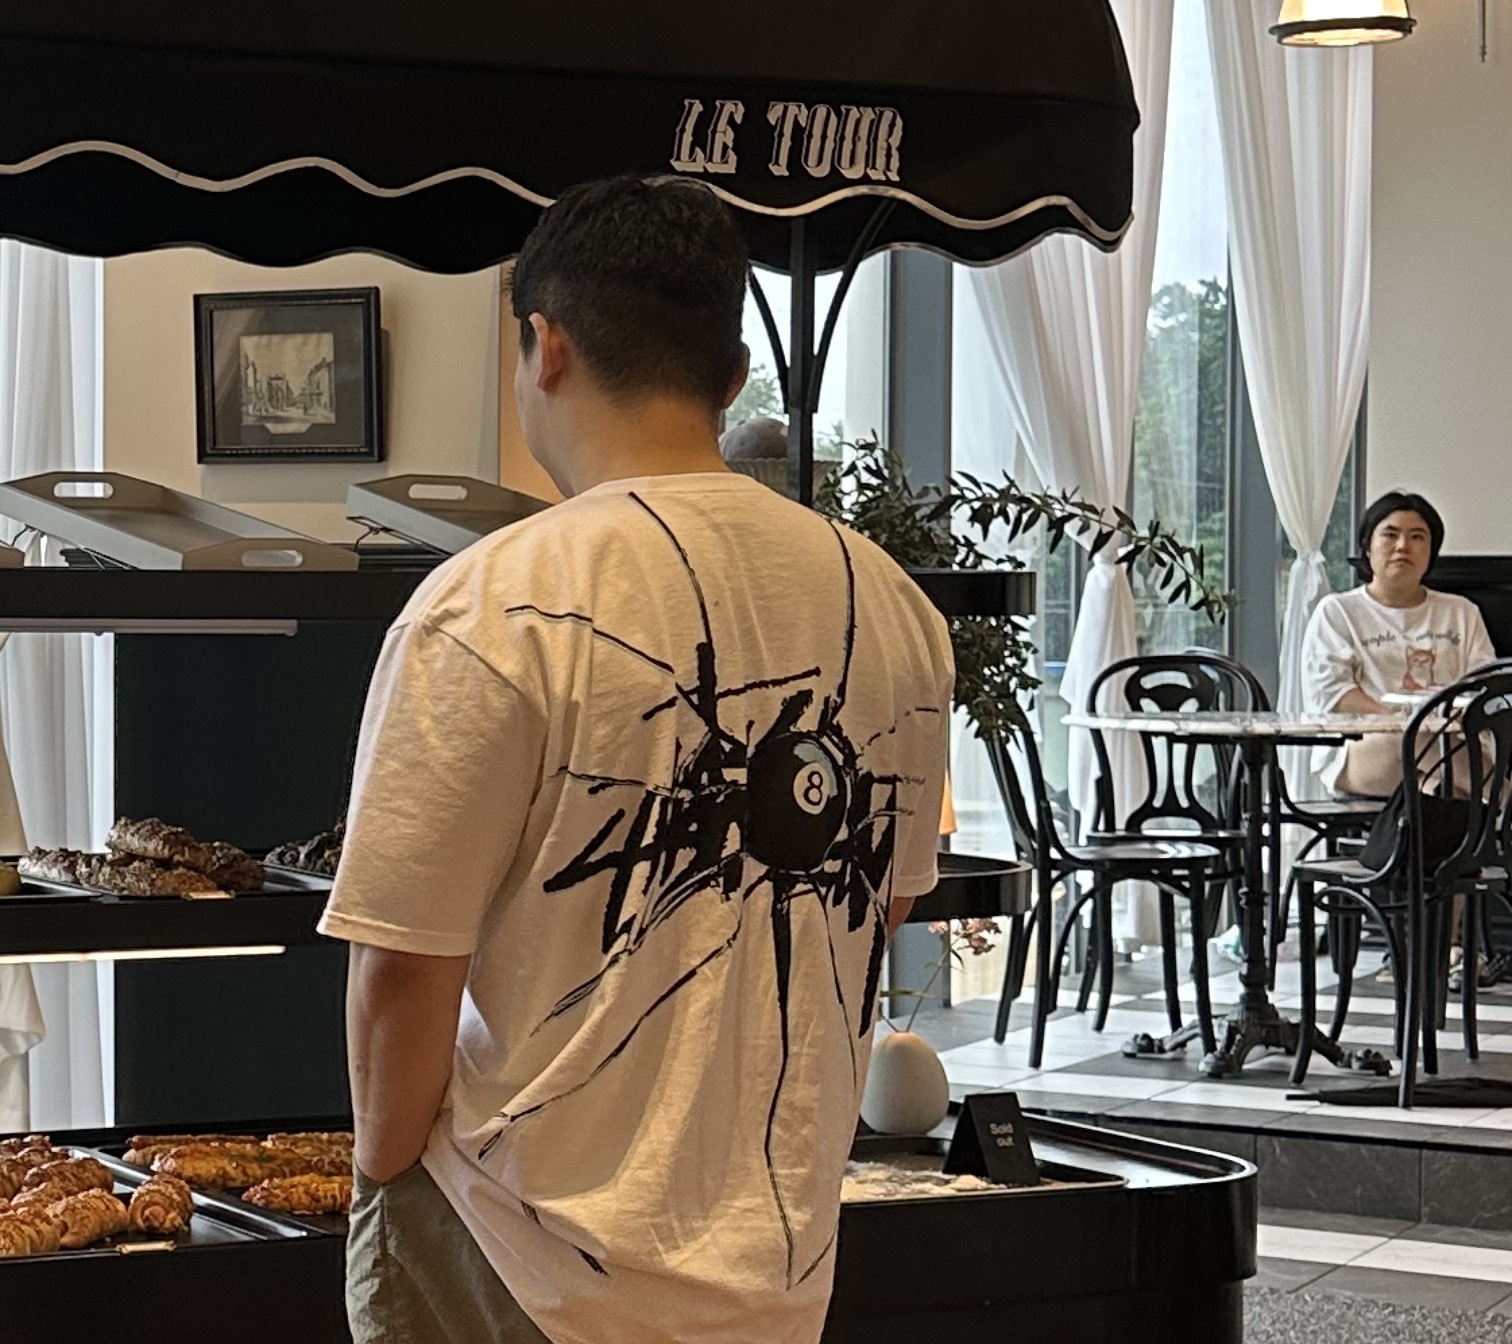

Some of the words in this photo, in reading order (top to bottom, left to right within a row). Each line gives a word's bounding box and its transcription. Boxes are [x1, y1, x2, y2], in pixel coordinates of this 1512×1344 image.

[669, 99, 744, 173] LE
[766, 101, 903, 181] TOUR
[803, 770, 824, 807] 8
